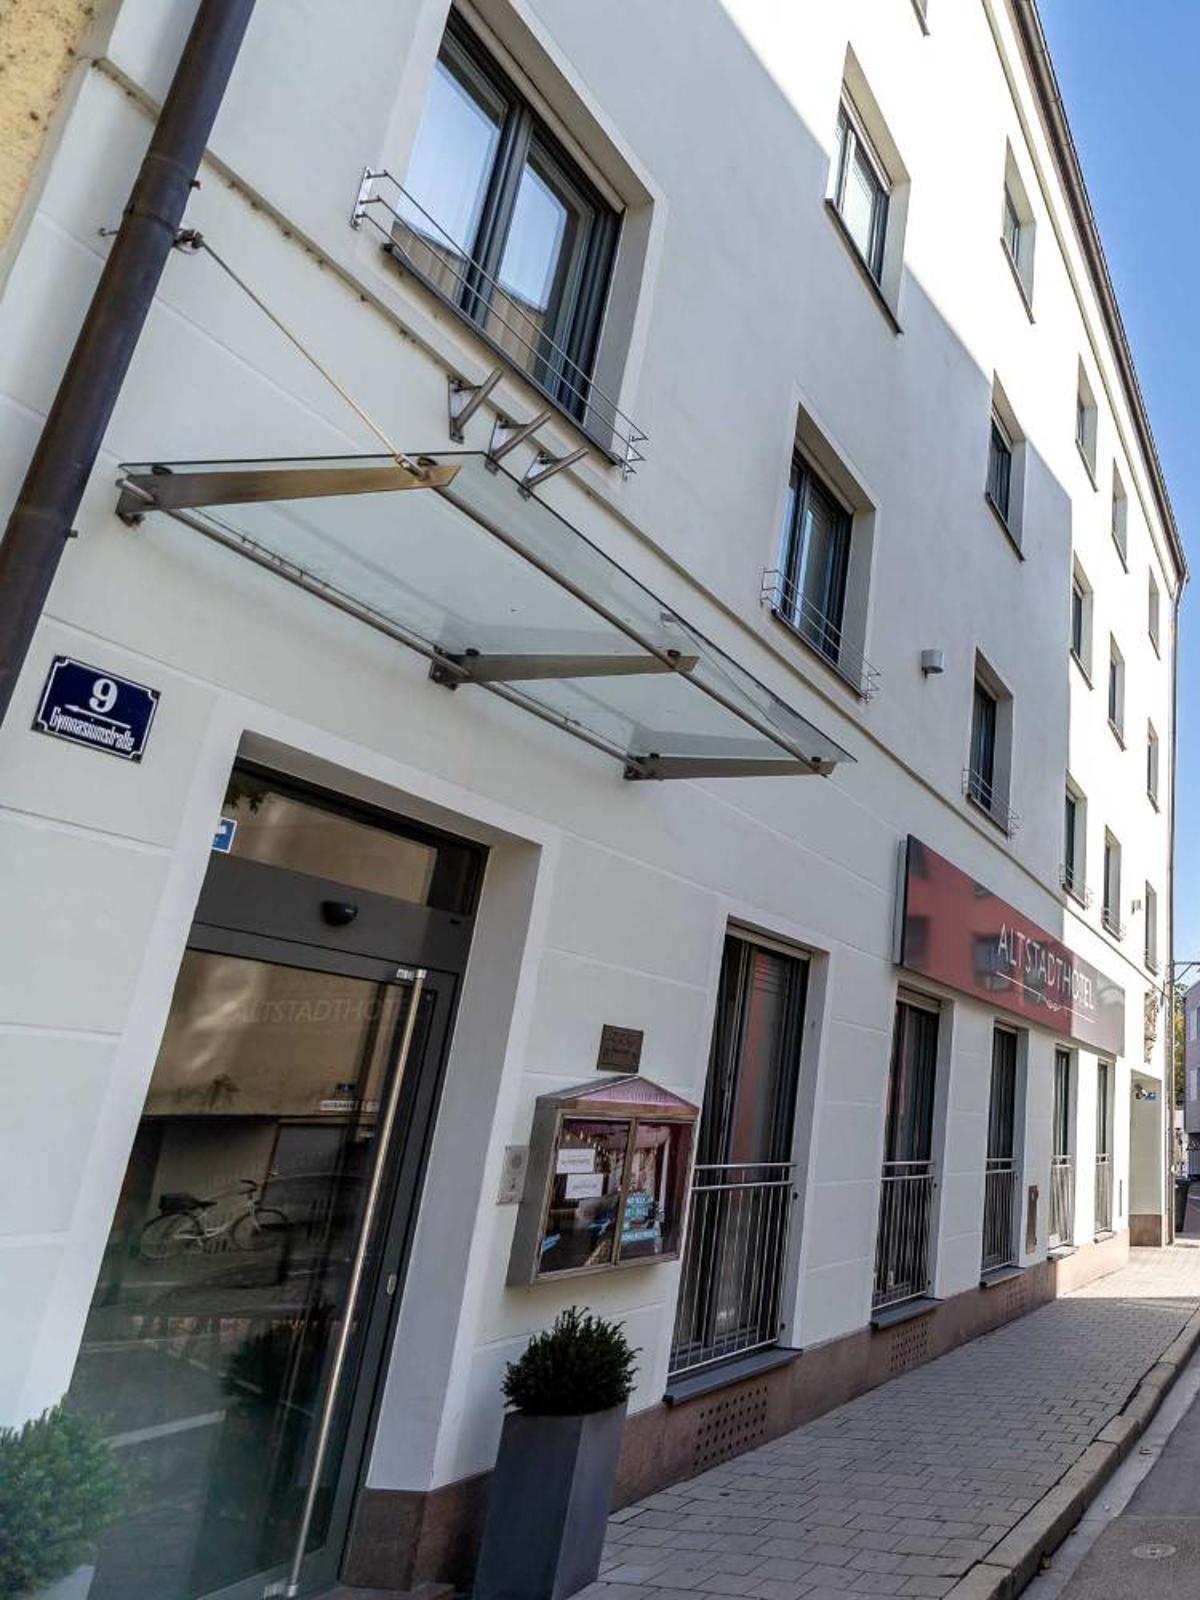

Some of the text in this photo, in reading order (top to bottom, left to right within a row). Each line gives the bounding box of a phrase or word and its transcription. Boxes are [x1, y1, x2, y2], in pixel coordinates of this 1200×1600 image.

[89, 678, 118, 713] 9
[49, 706, 135, 752] Gymnasiumstraße
[998, 922, 1096, 1011] ALTSTADTHOTEL
